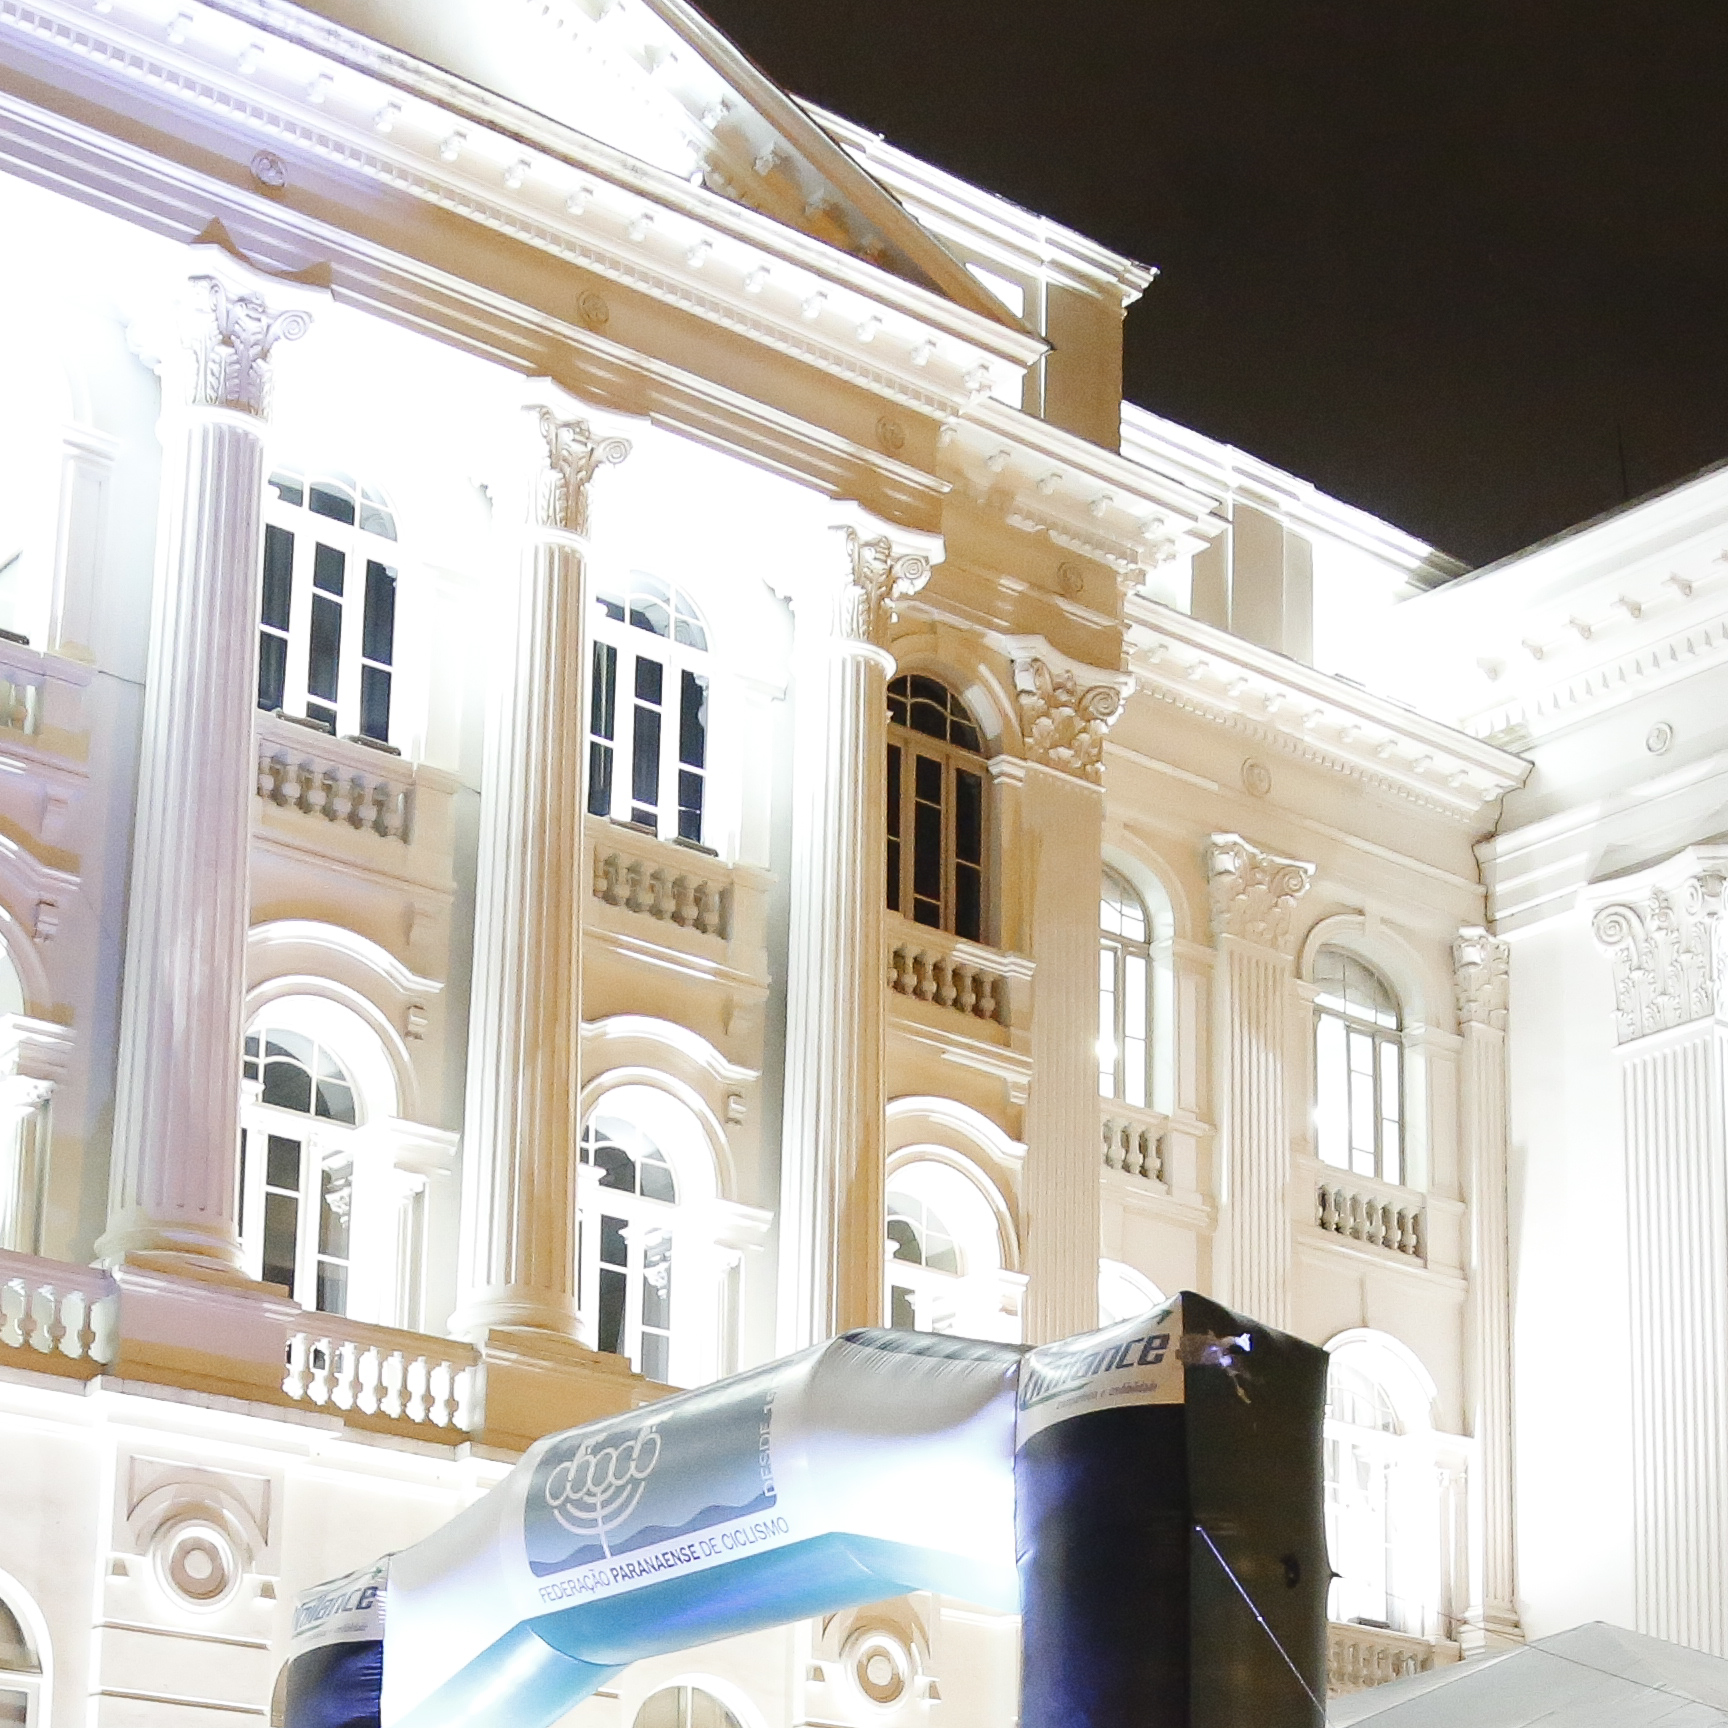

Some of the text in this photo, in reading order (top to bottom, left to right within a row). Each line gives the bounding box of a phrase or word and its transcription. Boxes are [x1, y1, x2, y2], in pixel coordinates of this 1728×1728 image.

[539, 1516, 790, 1604] FEDERAÇÃO PARANAENSE DE CICLISMO
